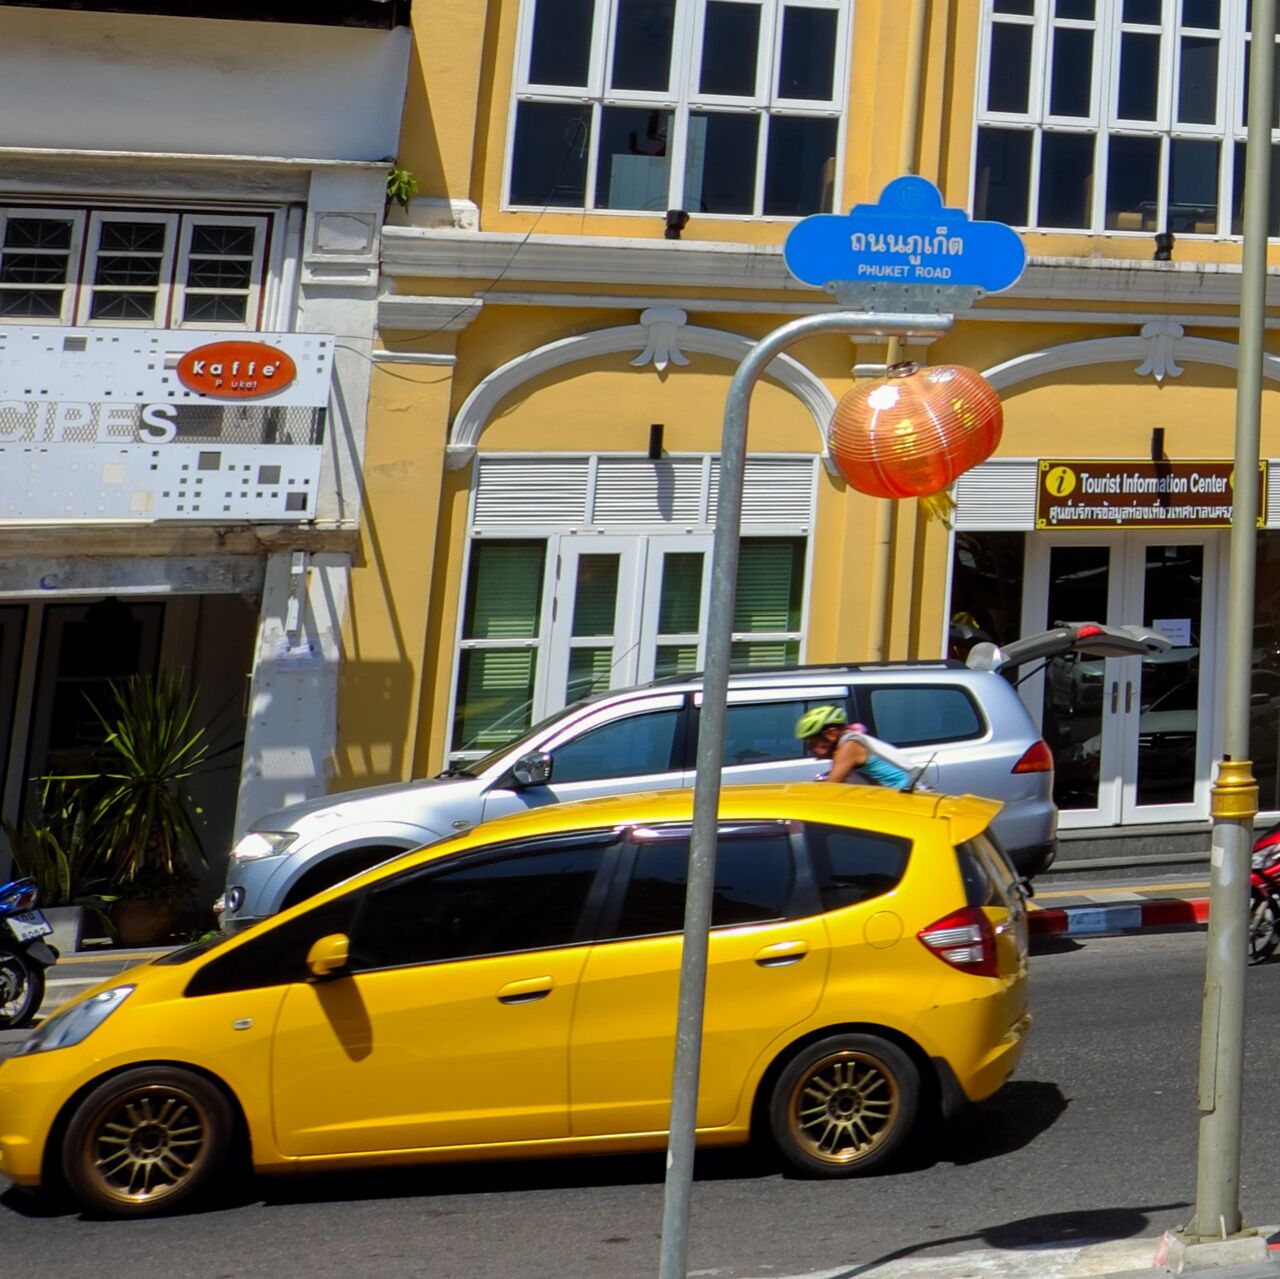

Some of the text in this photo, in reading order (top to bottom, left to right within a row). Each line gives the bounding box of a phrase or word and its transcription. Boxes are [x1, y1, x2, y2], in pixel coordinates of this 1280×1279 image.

[850, 226, 964, 265] ถนนภูเก็ต
[857, 263, 952, 279] PHUKET ROAD
[1080, 472, 1121, 494] Tourist
[1122, 472, 1188, 494] Information
[1190, 472, 1228, 494] Center
